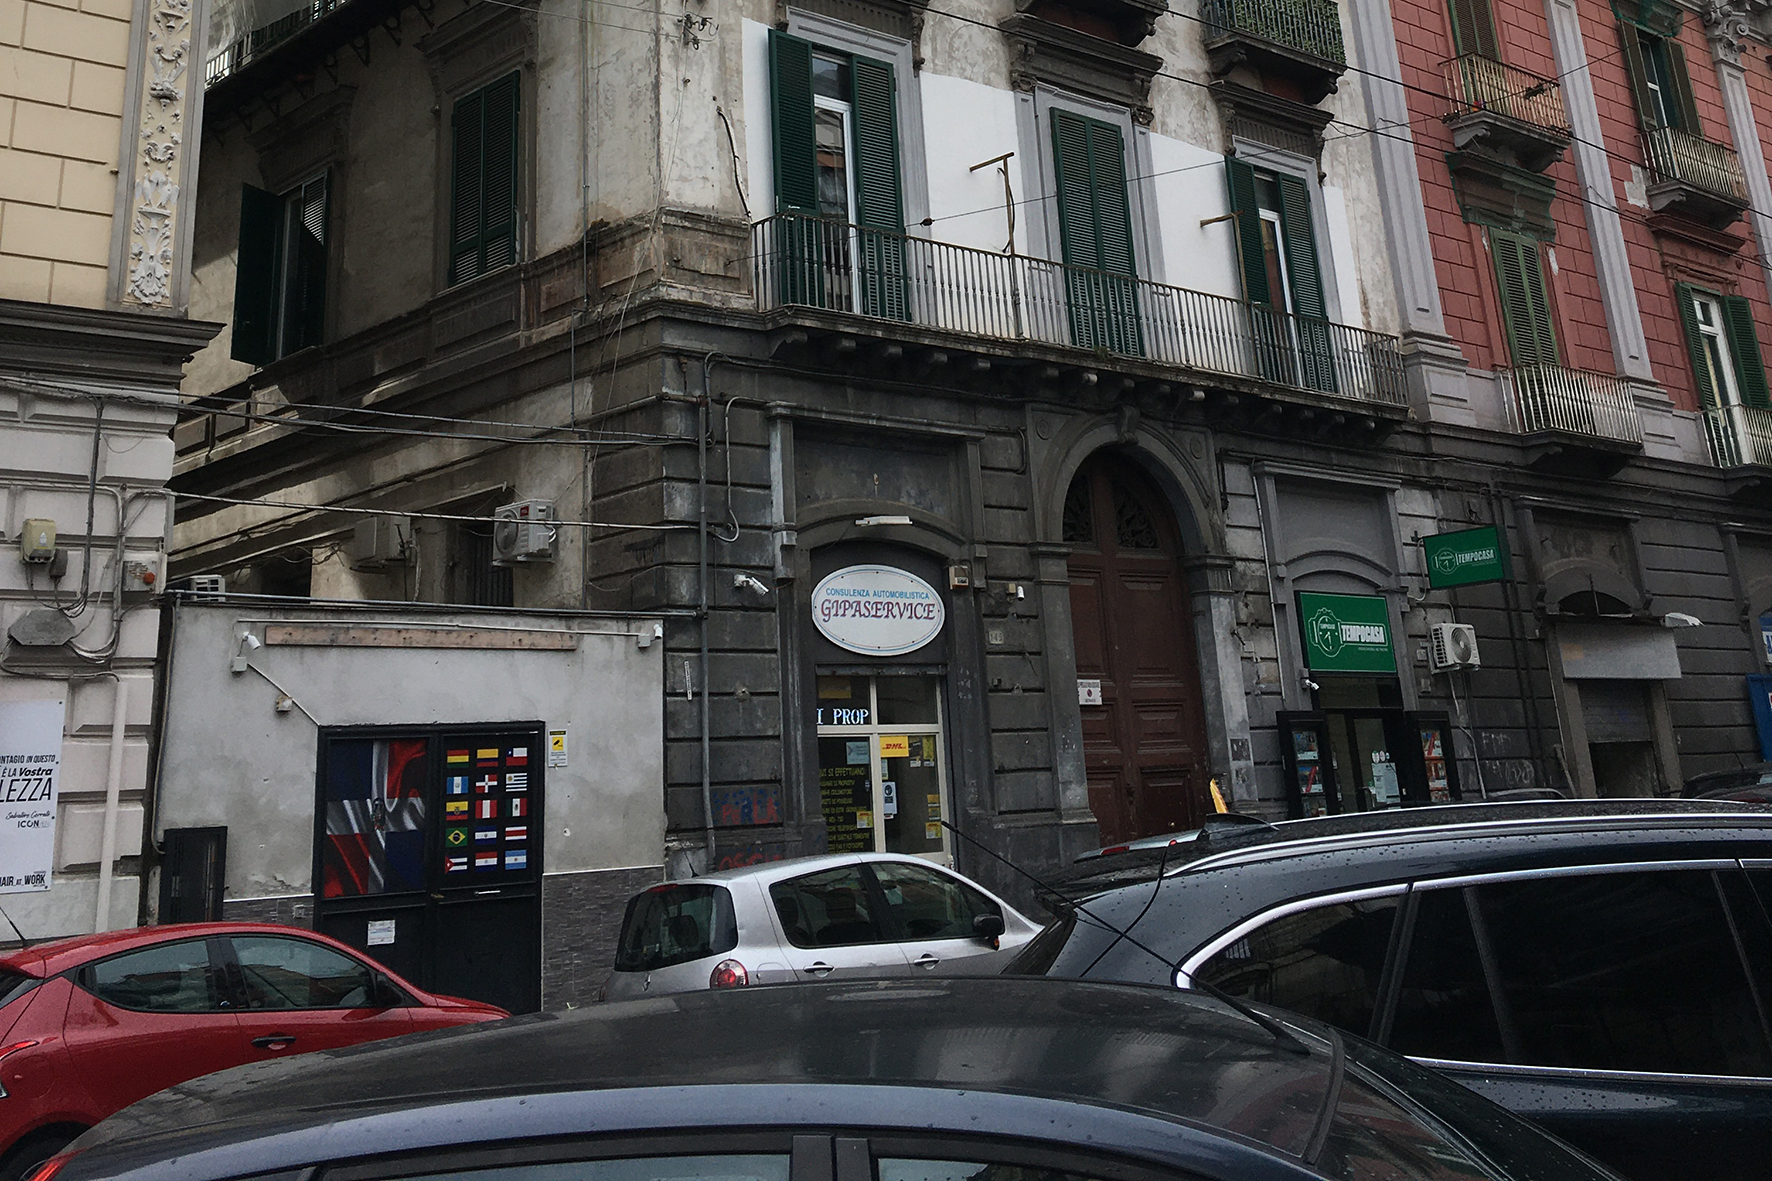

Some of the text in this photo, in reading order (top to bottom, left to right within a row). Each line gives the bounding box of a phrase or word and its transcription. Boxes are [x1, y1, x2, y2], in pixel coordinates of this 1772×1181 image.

[1458, 549, 1495, 564] TEMPOCASA
[826, 587, 930, 600] CONSULENZA AUTOMOBILISTICA
[820, 599, 936, 623] GIPASERVICE
[1341, 624, 1385, 644] TEMPOCASA
[833, 708, 869, 725] PROP
[0, 754, 25, 764] NTAGIO
[33, 754, 56, 764] QUESTO
[8, 767, 17, 778] LA
[19, 766, 53, 777] Vostra
[17, 820, 40, 828] ICON
